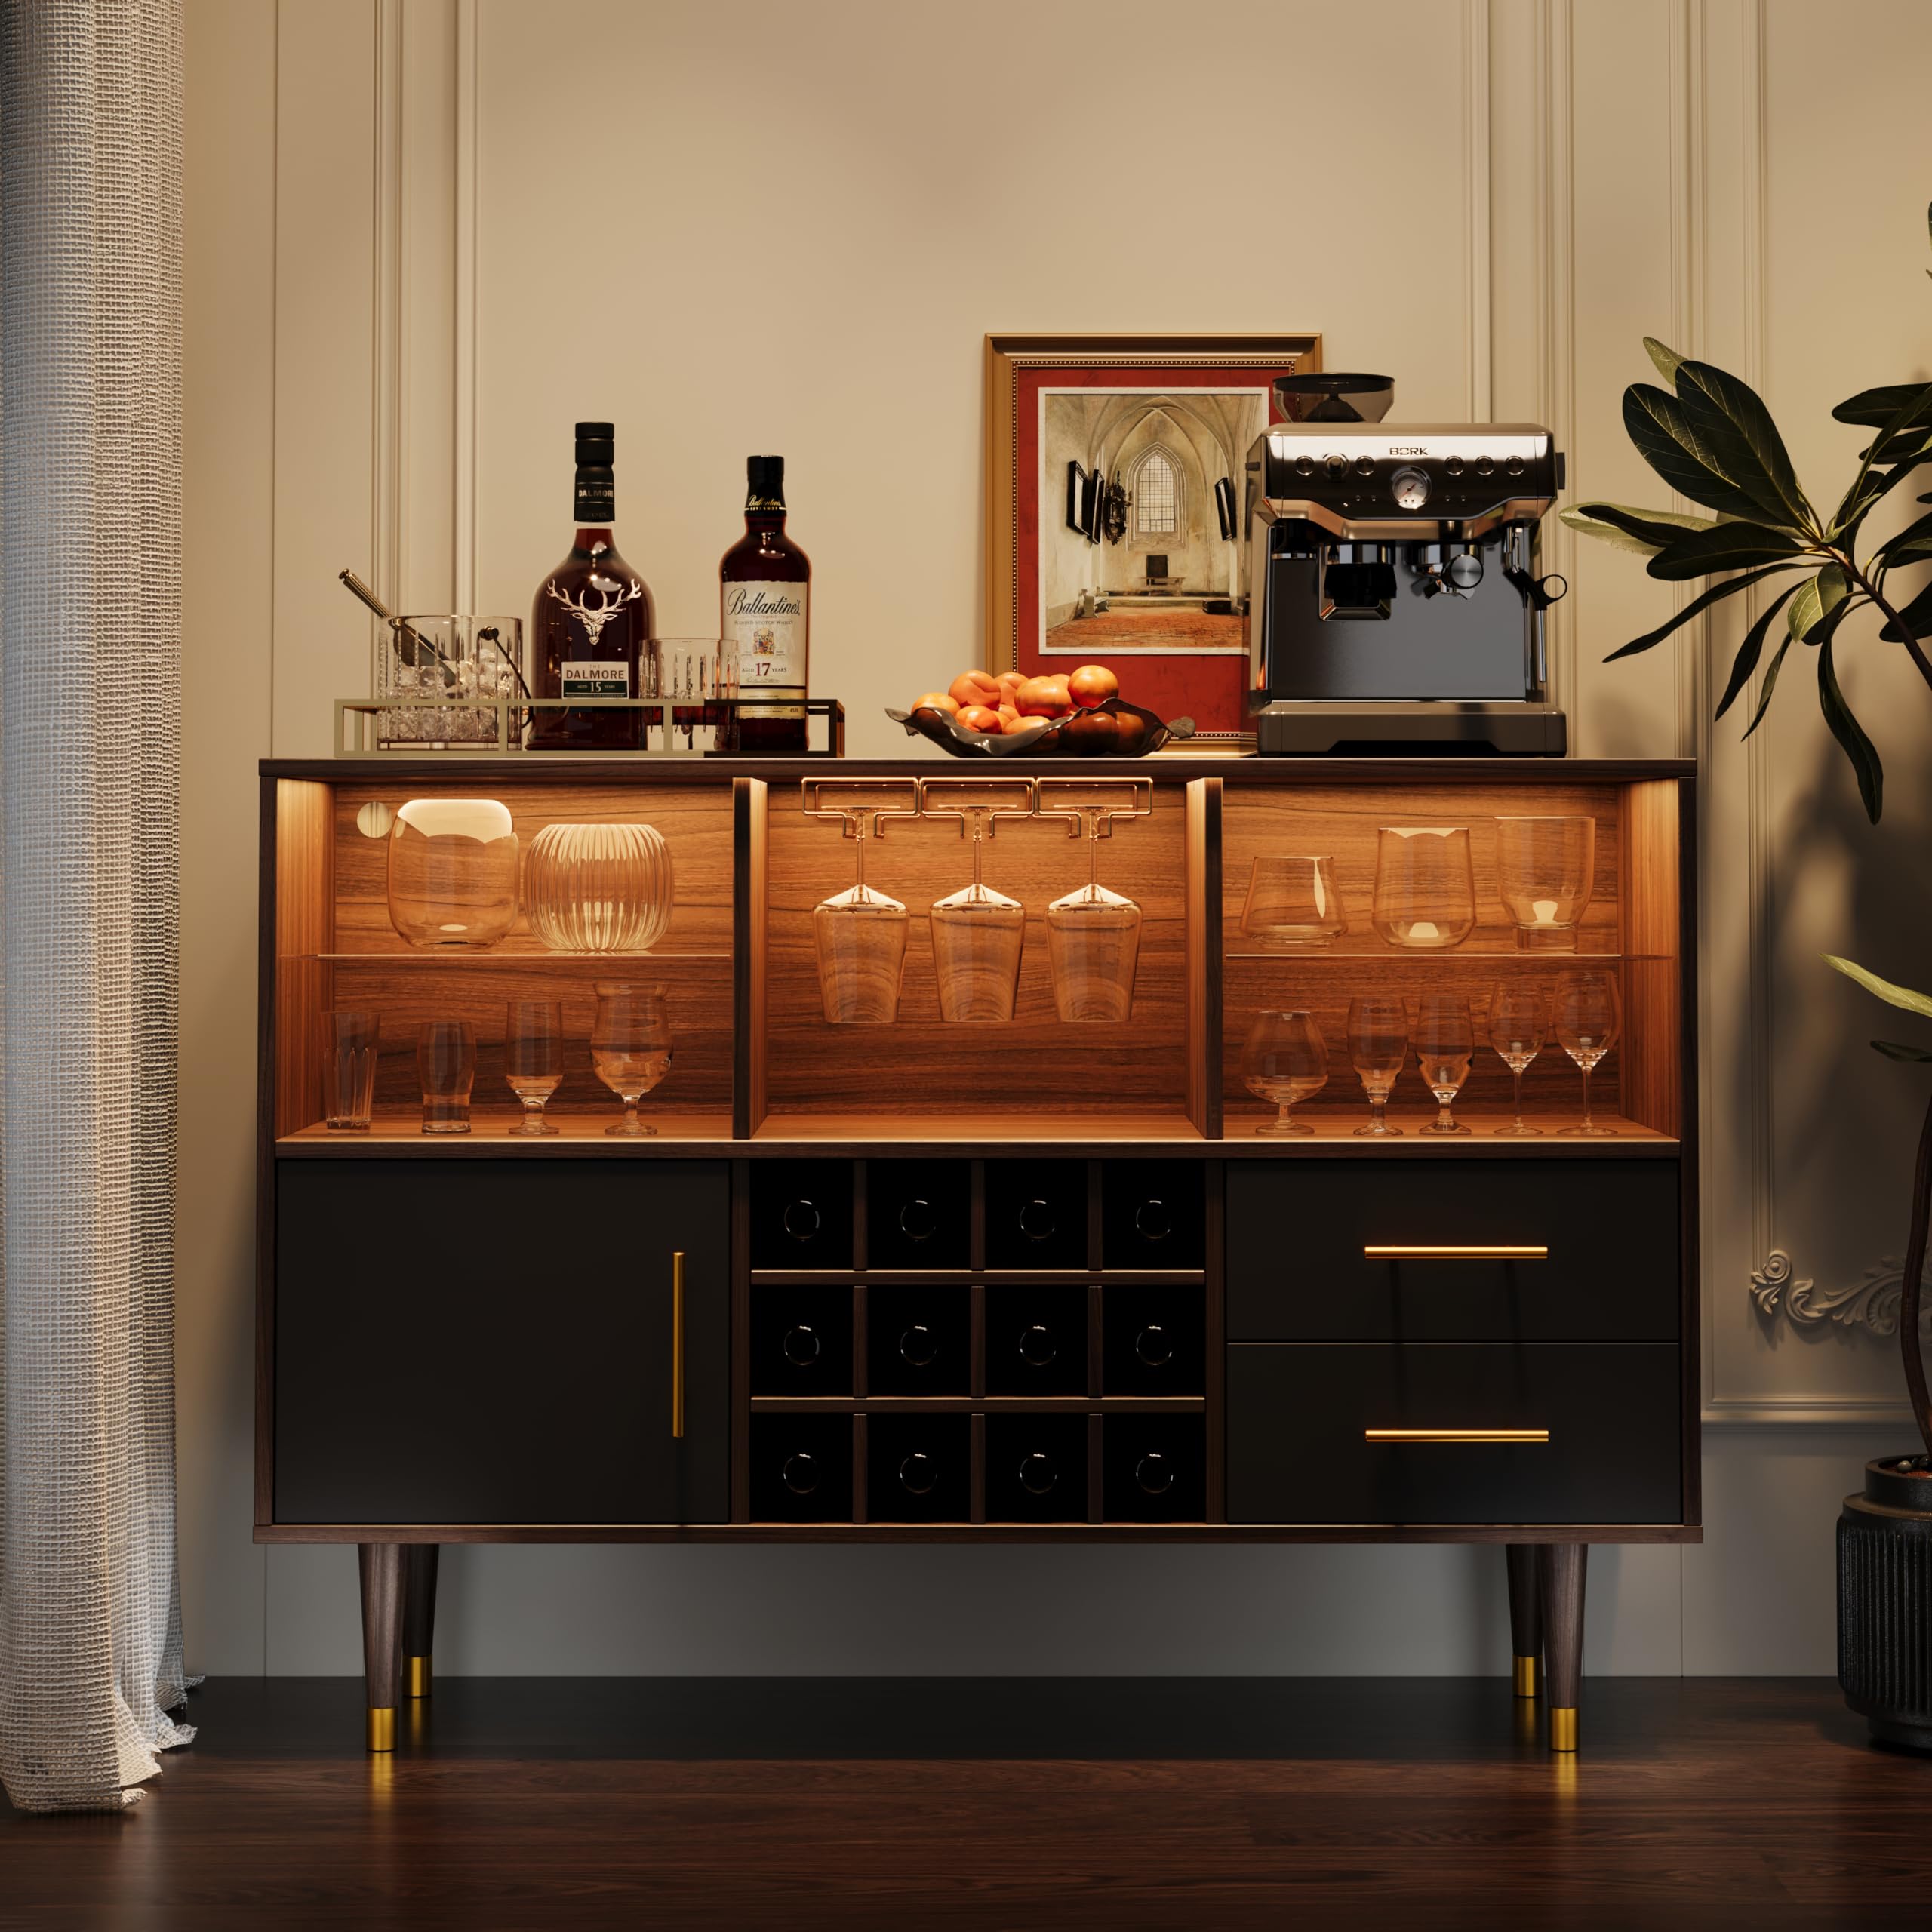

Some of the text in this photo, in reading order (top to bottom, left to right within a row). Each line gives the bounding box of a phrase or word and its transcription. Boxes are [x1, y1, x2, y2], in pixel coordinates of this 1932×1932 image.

[1389, 447, 1429, 456] BORK
[727, 588, 801, 616] Ballantine's
[566, 670, 624, 679] DALMORE
[755, 663, 771, 676] 17
[591, 681, 601, 692] 15
